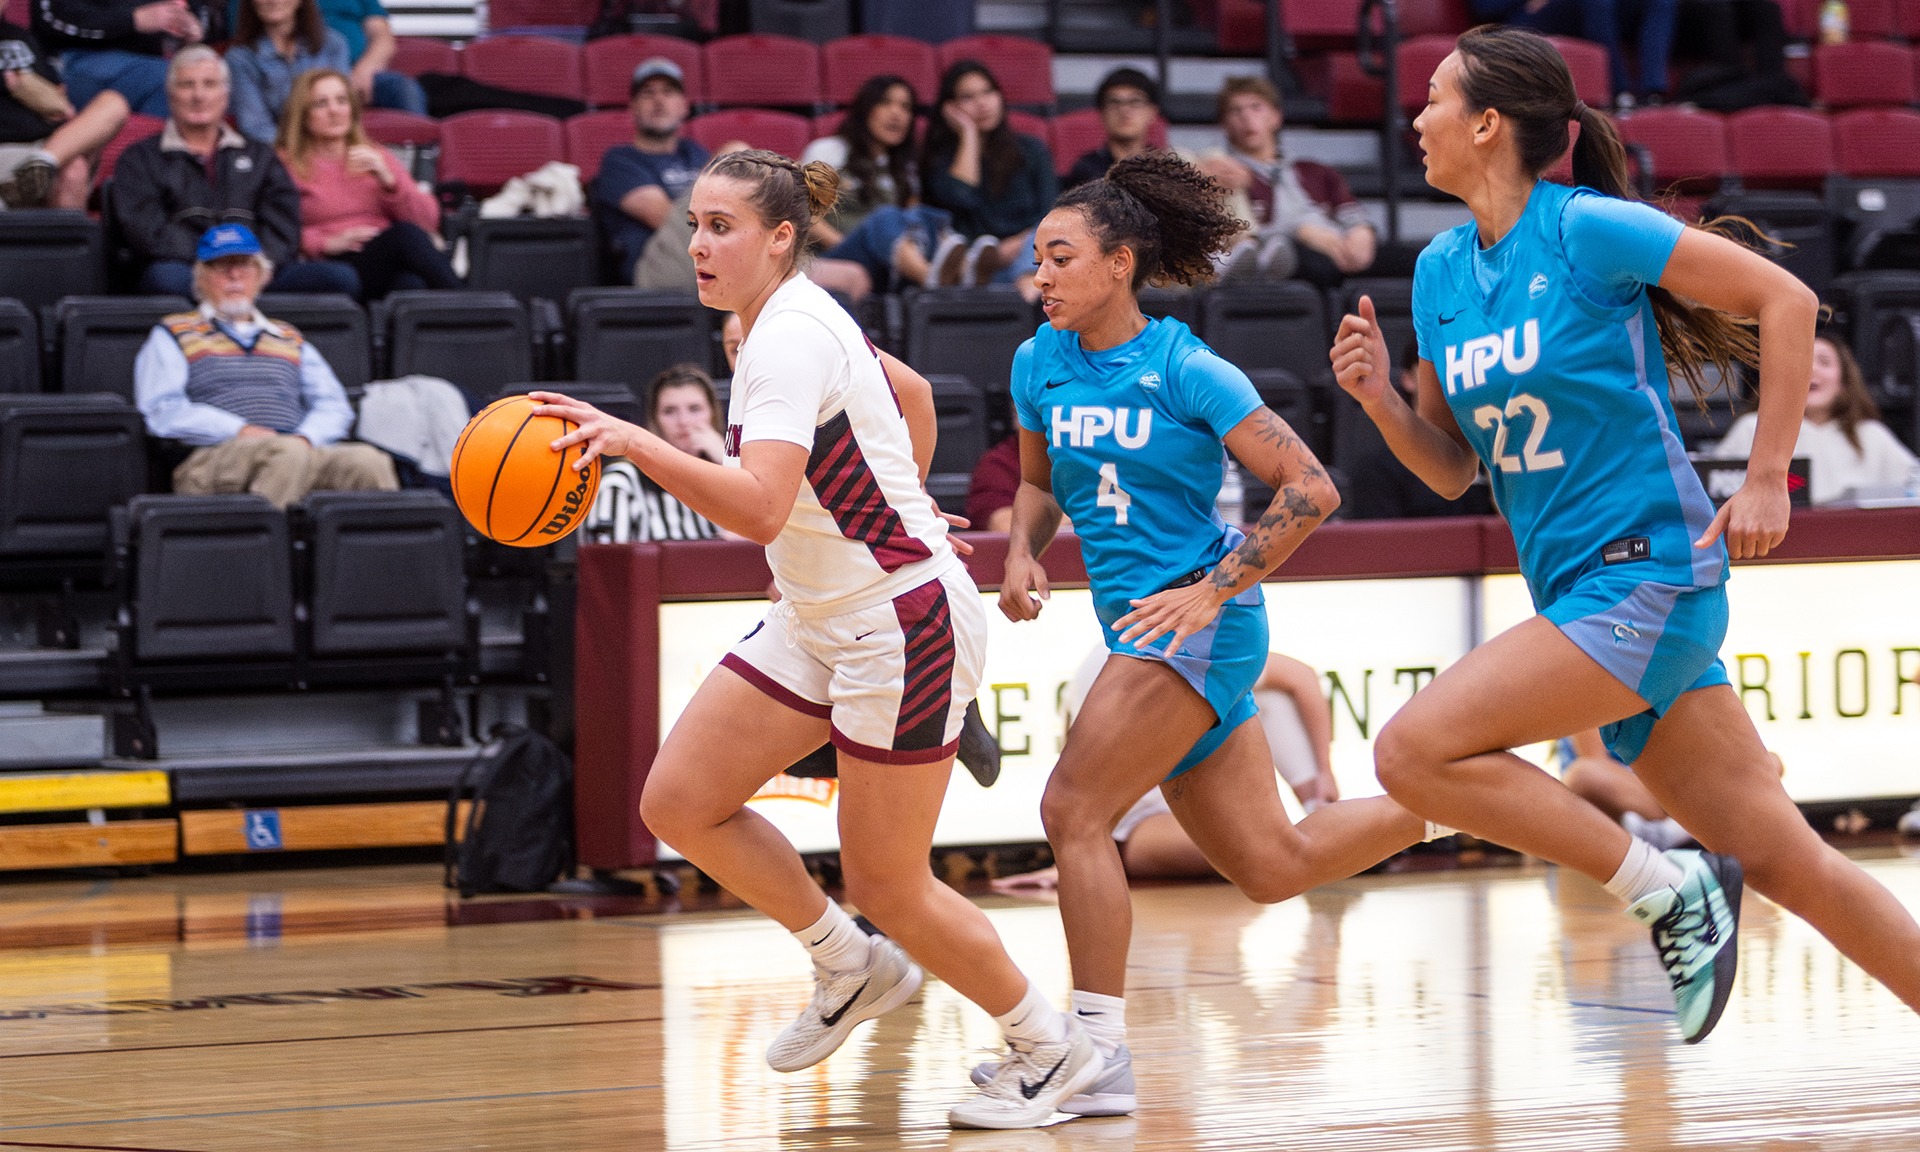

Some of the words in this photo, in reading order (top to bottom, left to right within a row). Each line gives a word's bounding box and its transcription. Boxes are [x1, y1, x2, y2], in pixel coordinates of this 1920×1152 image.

[1445, 318, 1540, 396] HPU
[1051, 405, 1152, 449] HPU
[1473, 393, 1566, 473] 22
[1097, 462, 1131, 525] 4
[1634, 542, 1644, 553] M
